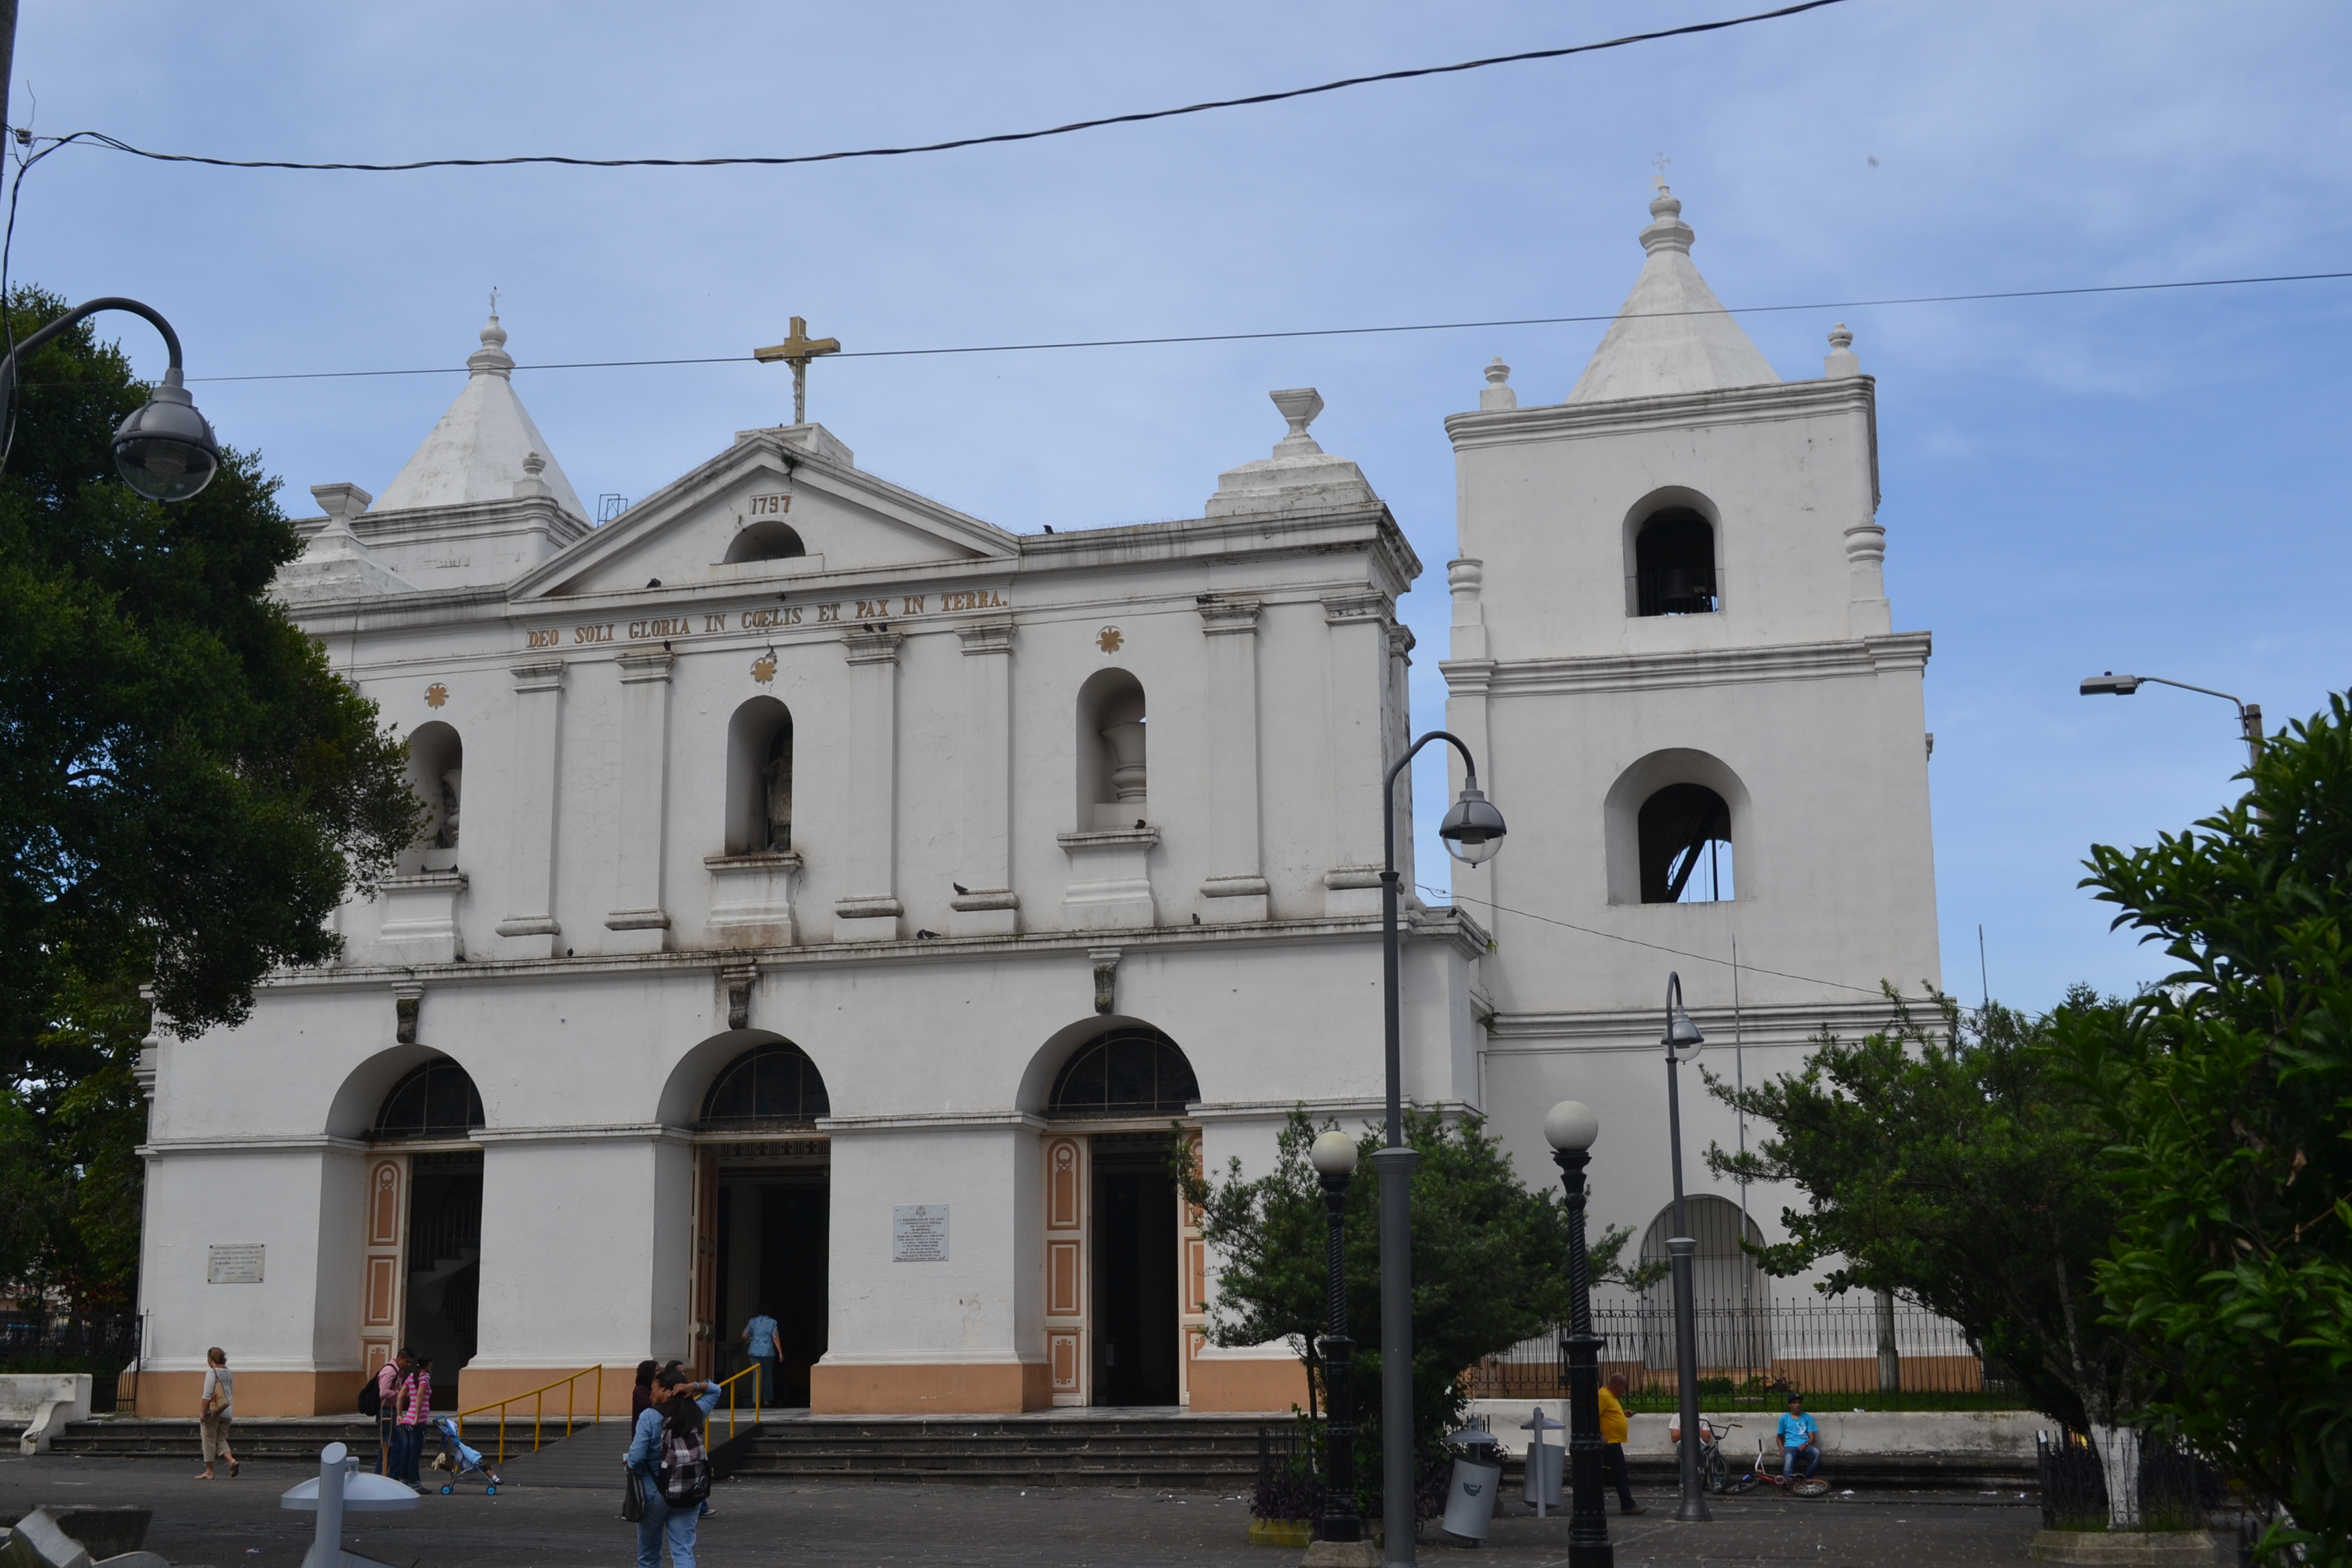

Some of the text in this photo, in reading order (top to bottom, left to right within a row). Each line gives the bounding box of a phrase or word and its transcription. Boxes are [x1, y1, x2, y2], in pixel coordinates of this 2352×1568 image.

[751, 495, 790, 514] 1797
[527, 630, 559, 648] DEO
[574, 624, 615, 644] SOLI
[628, 618, 691, 639] GLORIA
[704, 614, 726, 632] IN
[817, 603, 840, 622] ET
[855, 600, 889, 619] PAX
[902, 595, 925, 615] IN
[941, 590, 1009, 611] TERRA.
